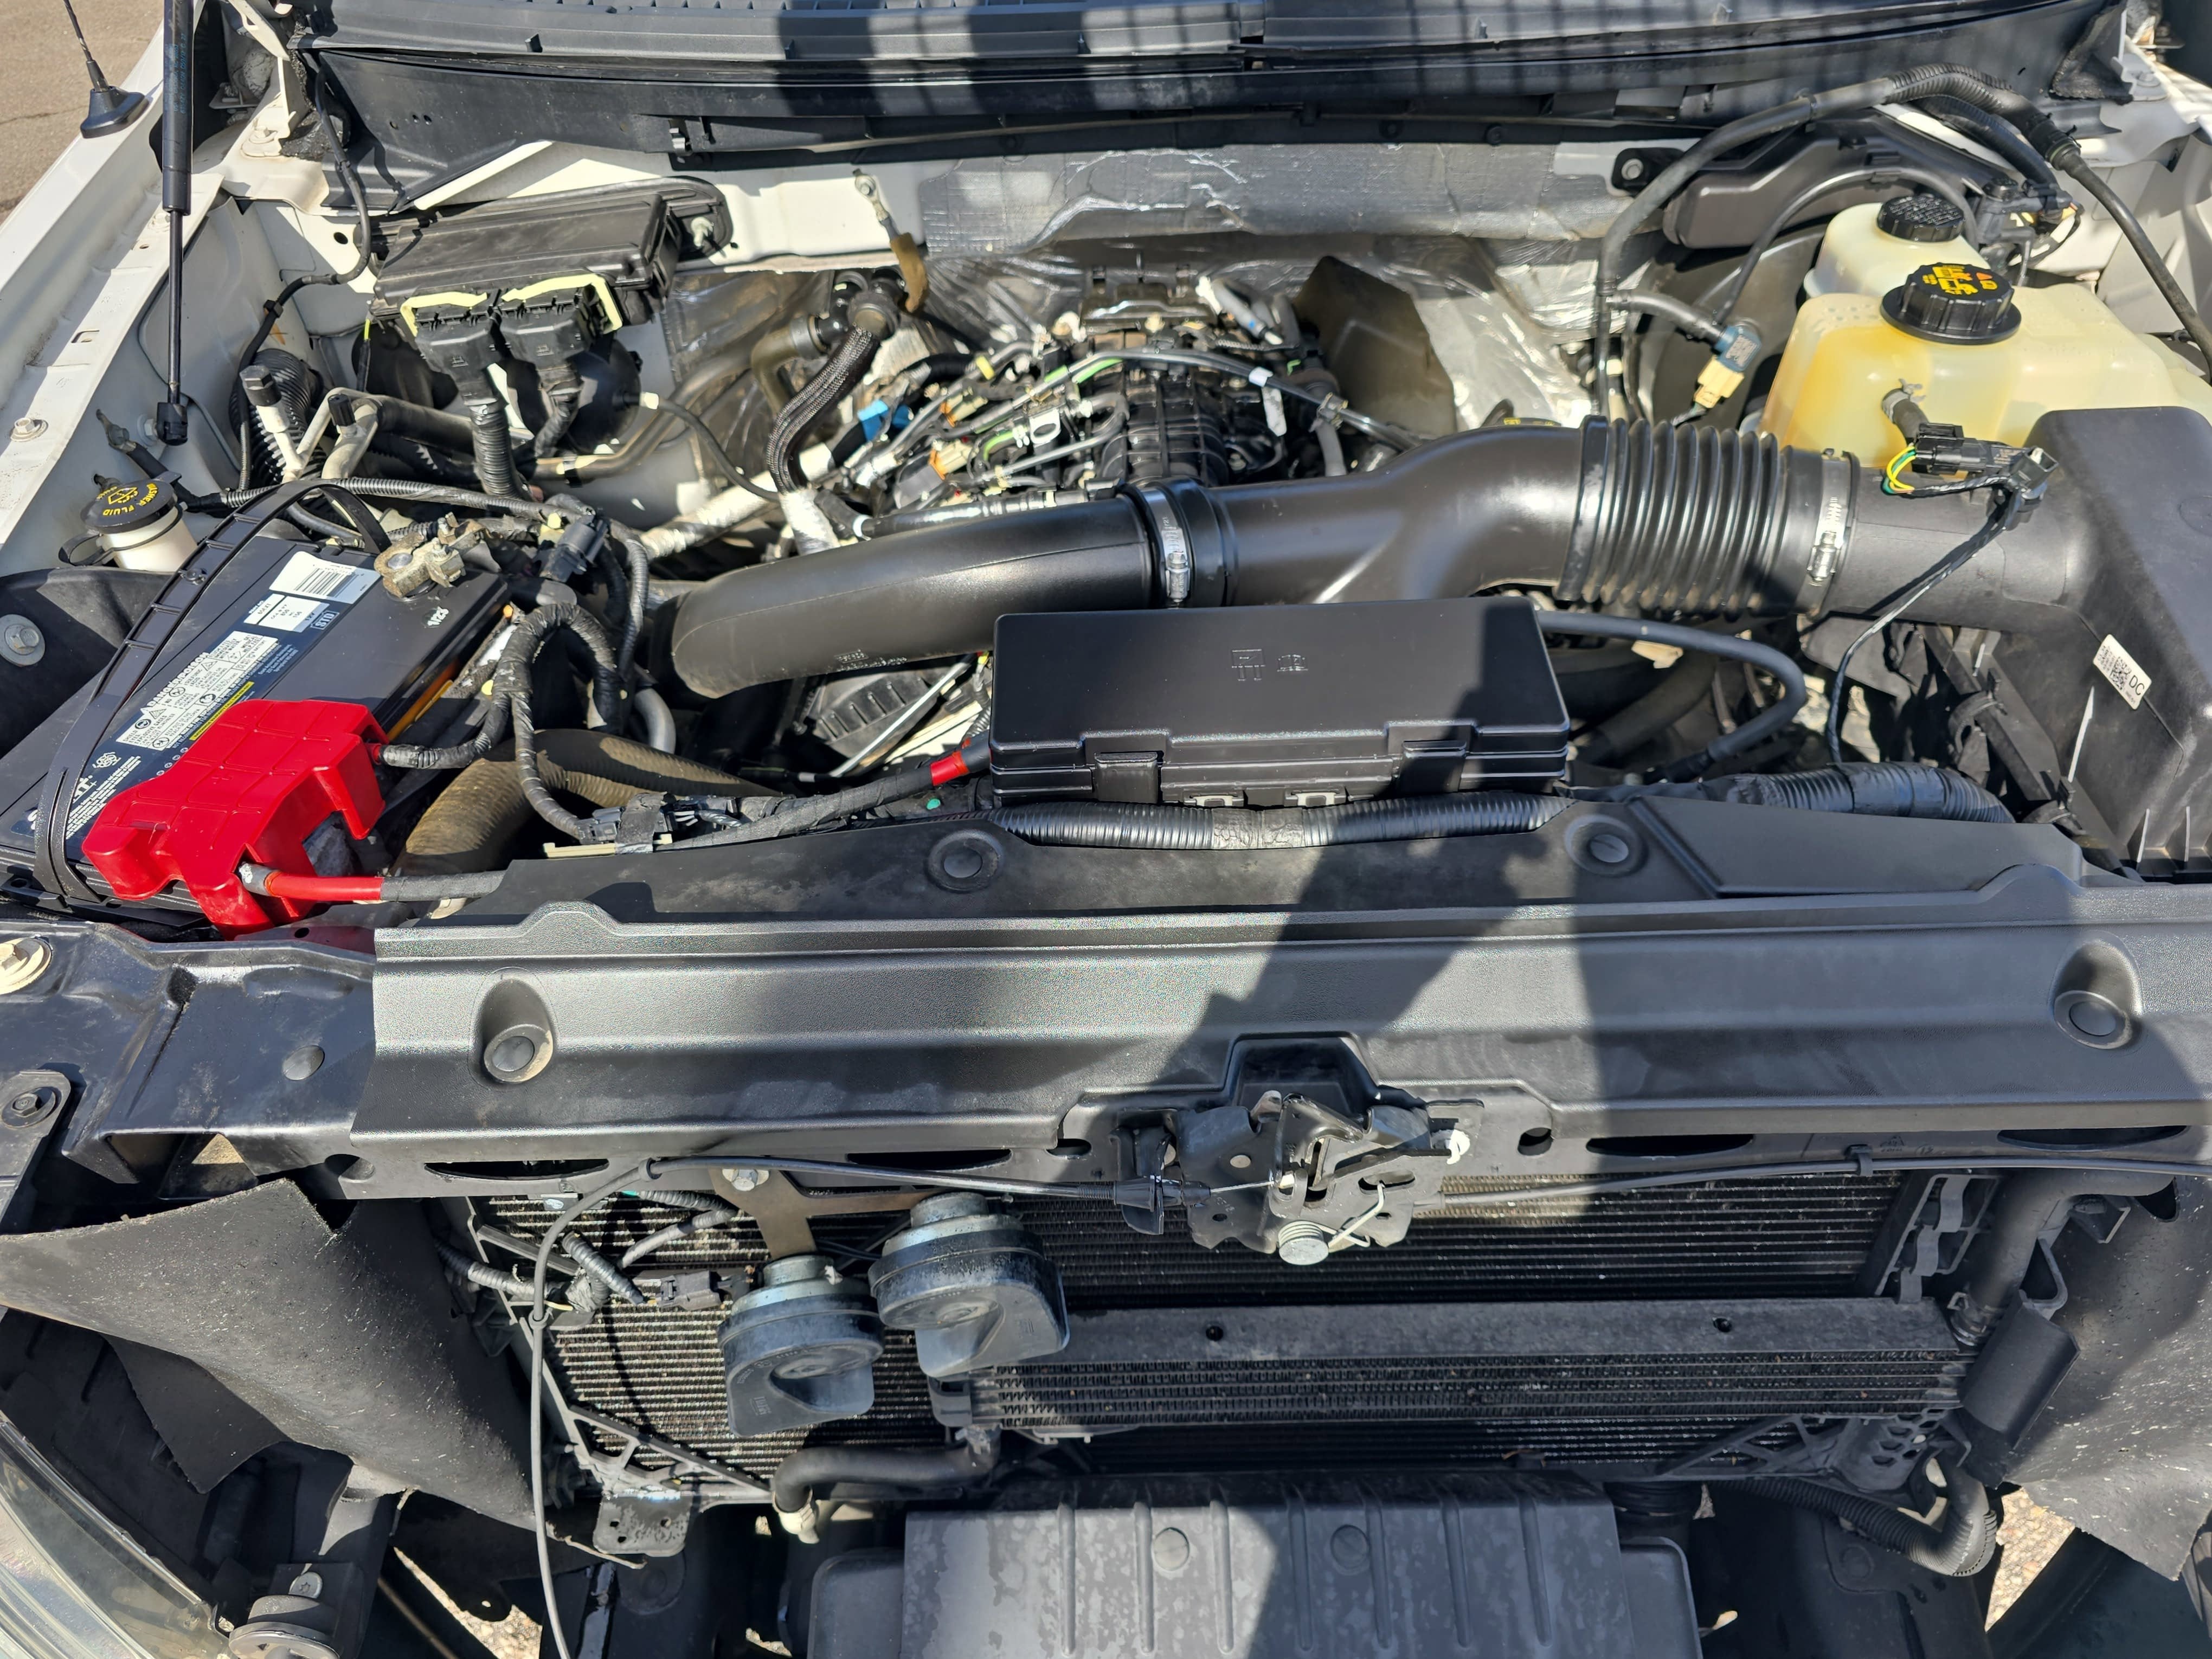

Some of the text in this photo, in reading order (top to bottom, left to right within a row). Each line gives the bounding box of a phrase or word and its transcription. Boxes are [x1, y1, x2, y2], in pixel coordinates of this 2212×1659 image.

[102, 483, 158, 516] WASHER FLUID
[316, 612, 336, 627] STD
[146, 652, 210, 707] DANGER/POISON
[2129, 675, 2145, 696] DC
[134, 715, 167, 744] EXPLOSIVE GASES
